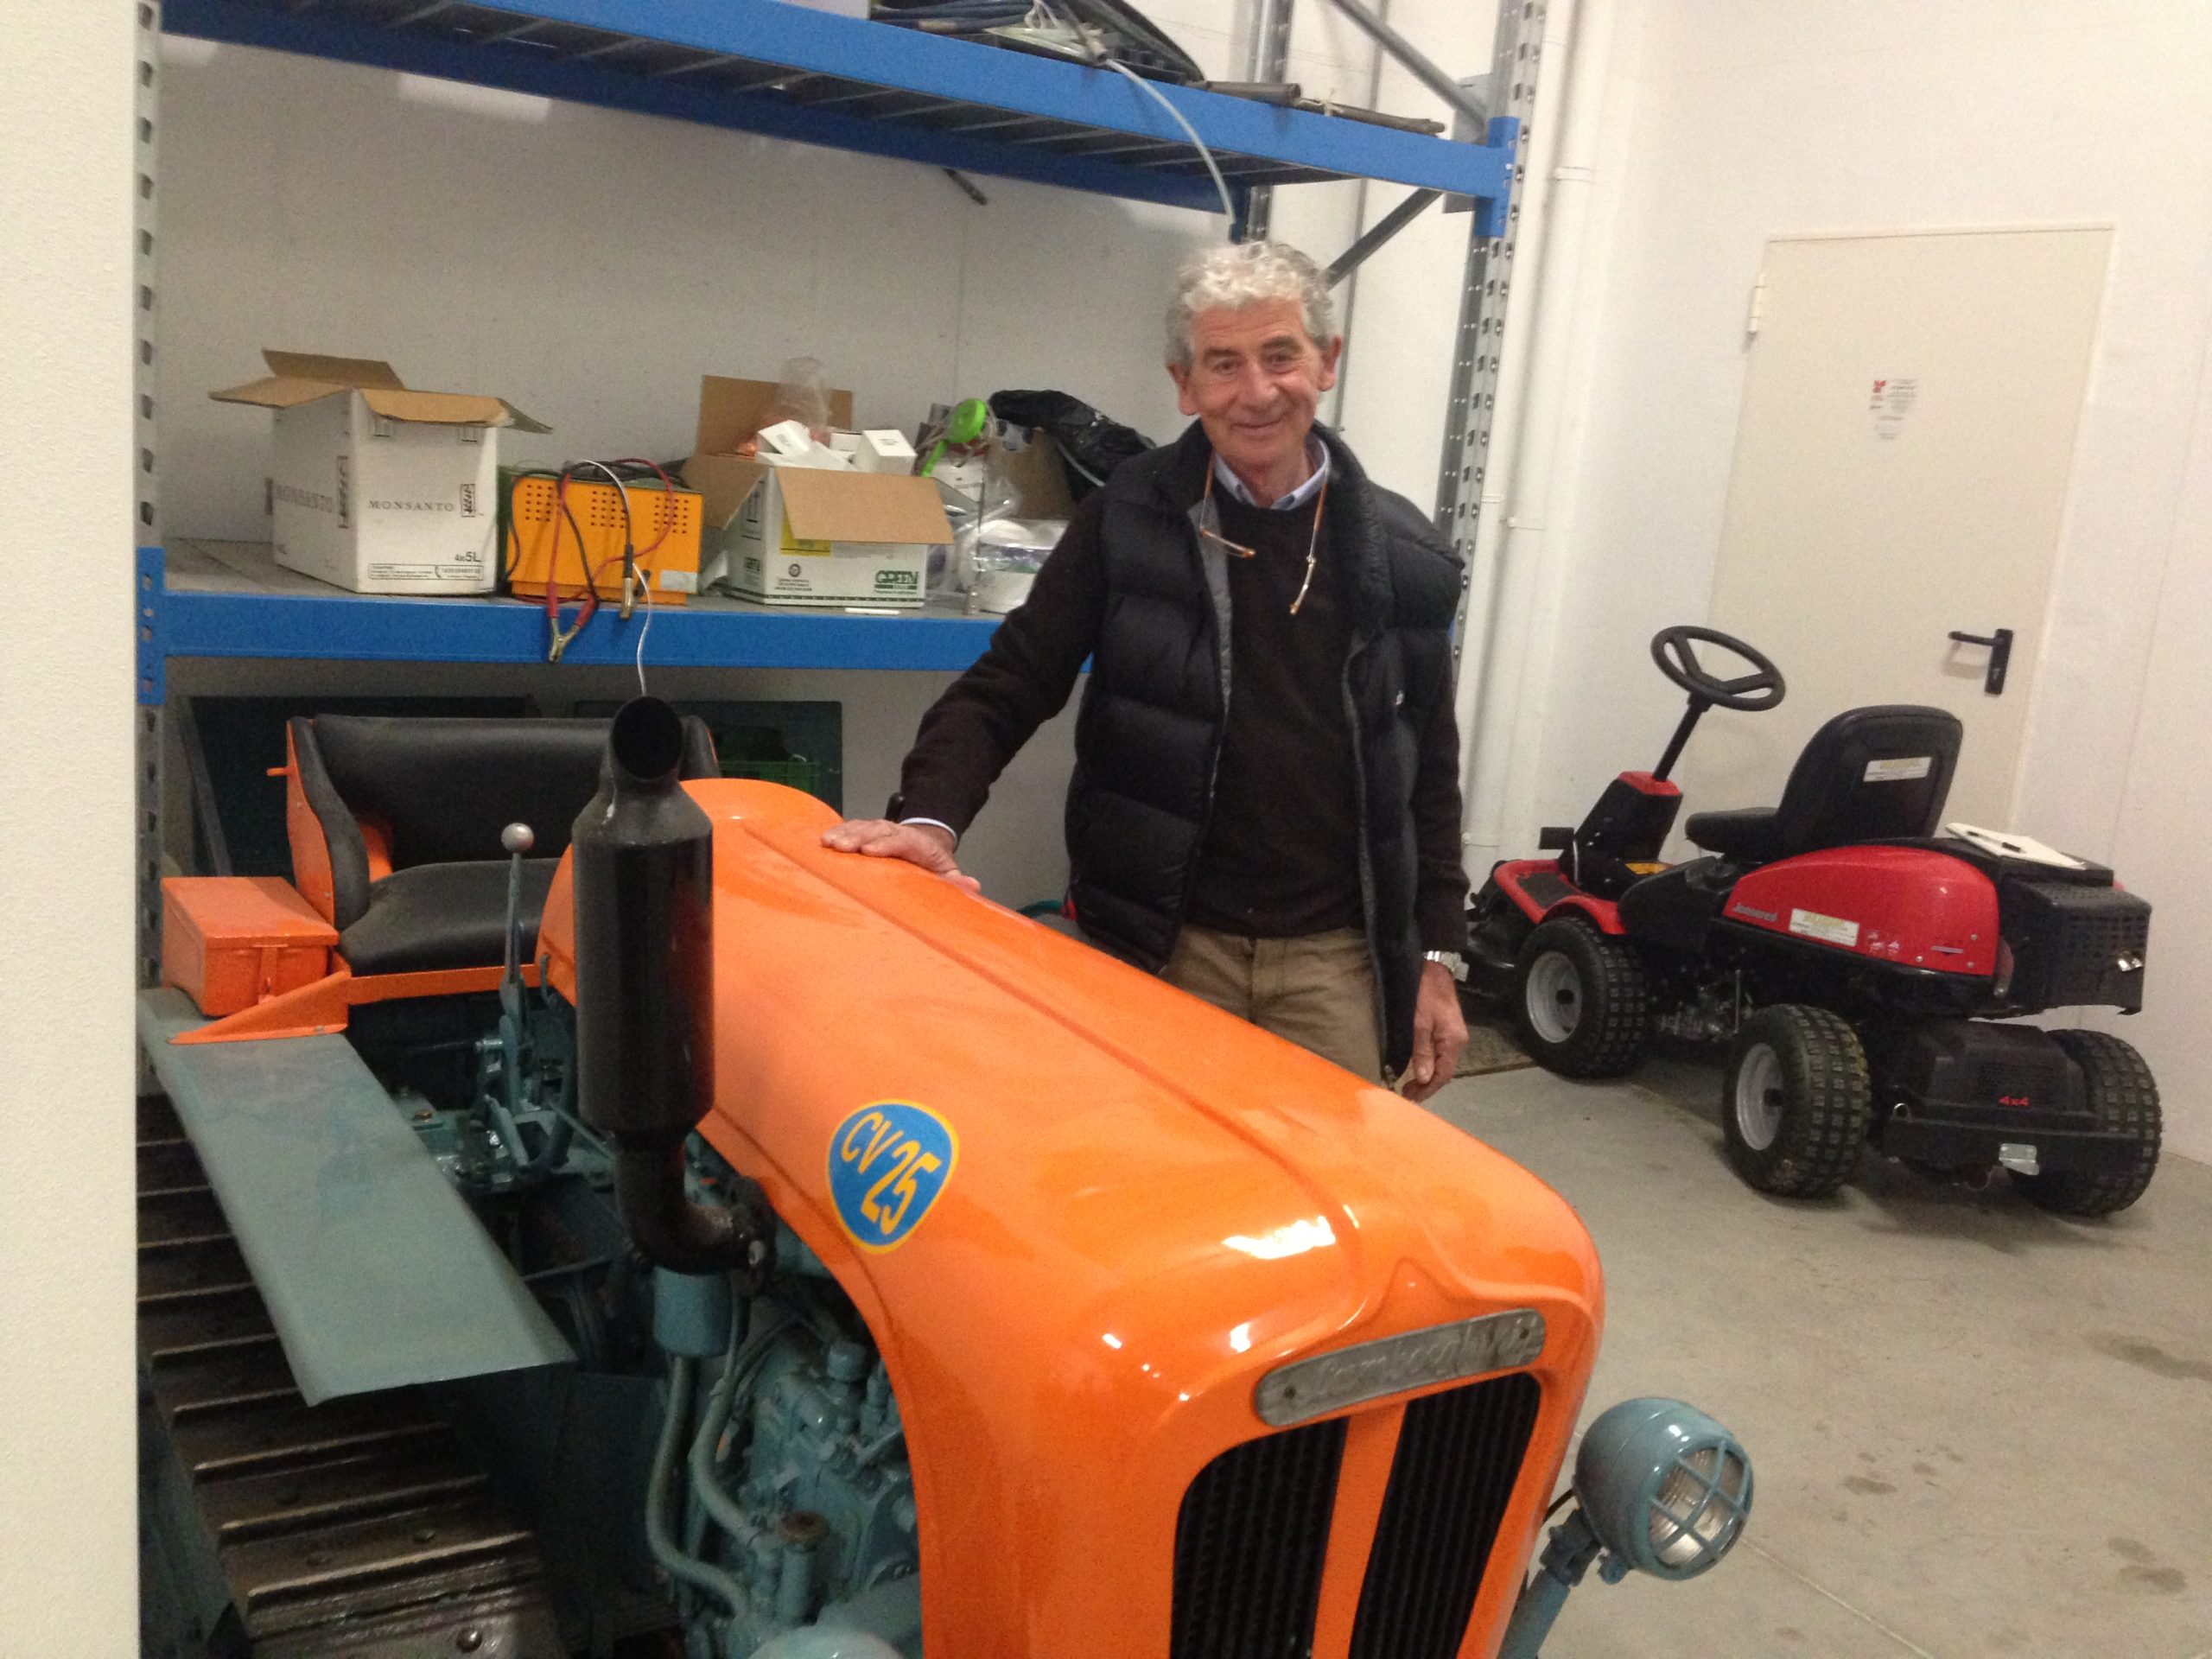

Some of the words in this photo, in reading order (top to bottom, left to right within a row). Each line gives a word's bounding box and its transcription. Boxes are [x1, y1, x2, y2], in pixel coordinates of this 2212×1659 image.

[368, 499, 454, 512] MONSANTO
[1998, 1095, 2030, 1107] 4x4
[842, 1111, 905, 1174] CV
[861, 1140, 944, 1235] 25
